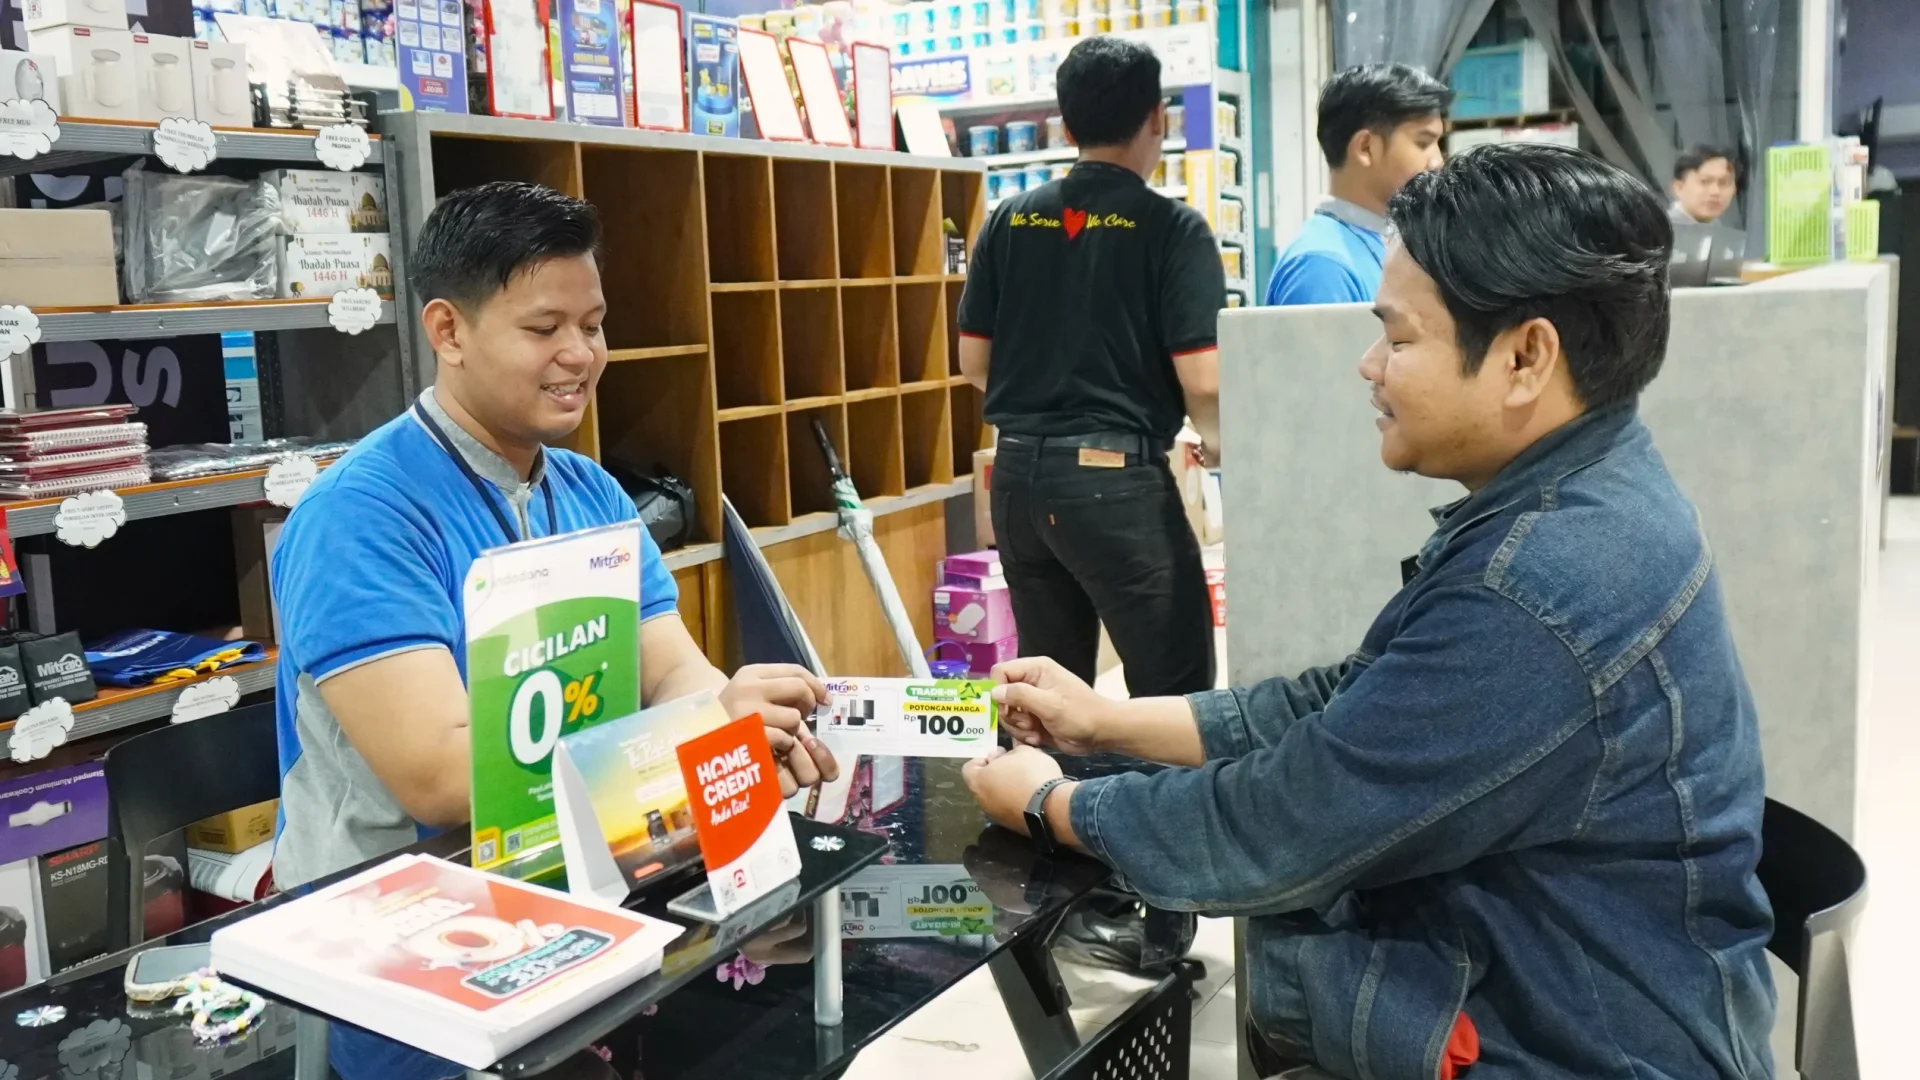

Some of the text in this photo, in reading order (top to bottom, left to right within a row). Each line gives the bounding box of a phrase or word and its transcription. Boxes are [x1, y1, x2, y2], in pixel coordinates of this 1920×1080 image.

[324, 196, 349, 206] Puasa
[307, 208, 339, 217] 1446 H
[1010, 212, 1136, 229] We Serve We Care
[299, 259, 360, 269] Ibadah Puasa
[313, 271, 347, 281] 1446 H
[504, 615, 606, 677] CICILAN
[911, 687, 957, 696] TRADE-IN
[910, 704, 952, 712] POTONGAN
[696, 744, 751, 785] HOME
[74, 770, 104, 781] Stamped
[36, 777, 72, 791] Aluminum
[703, 762, 761, 806] CREDIT
[48, 844, 99, 868] SHARP
